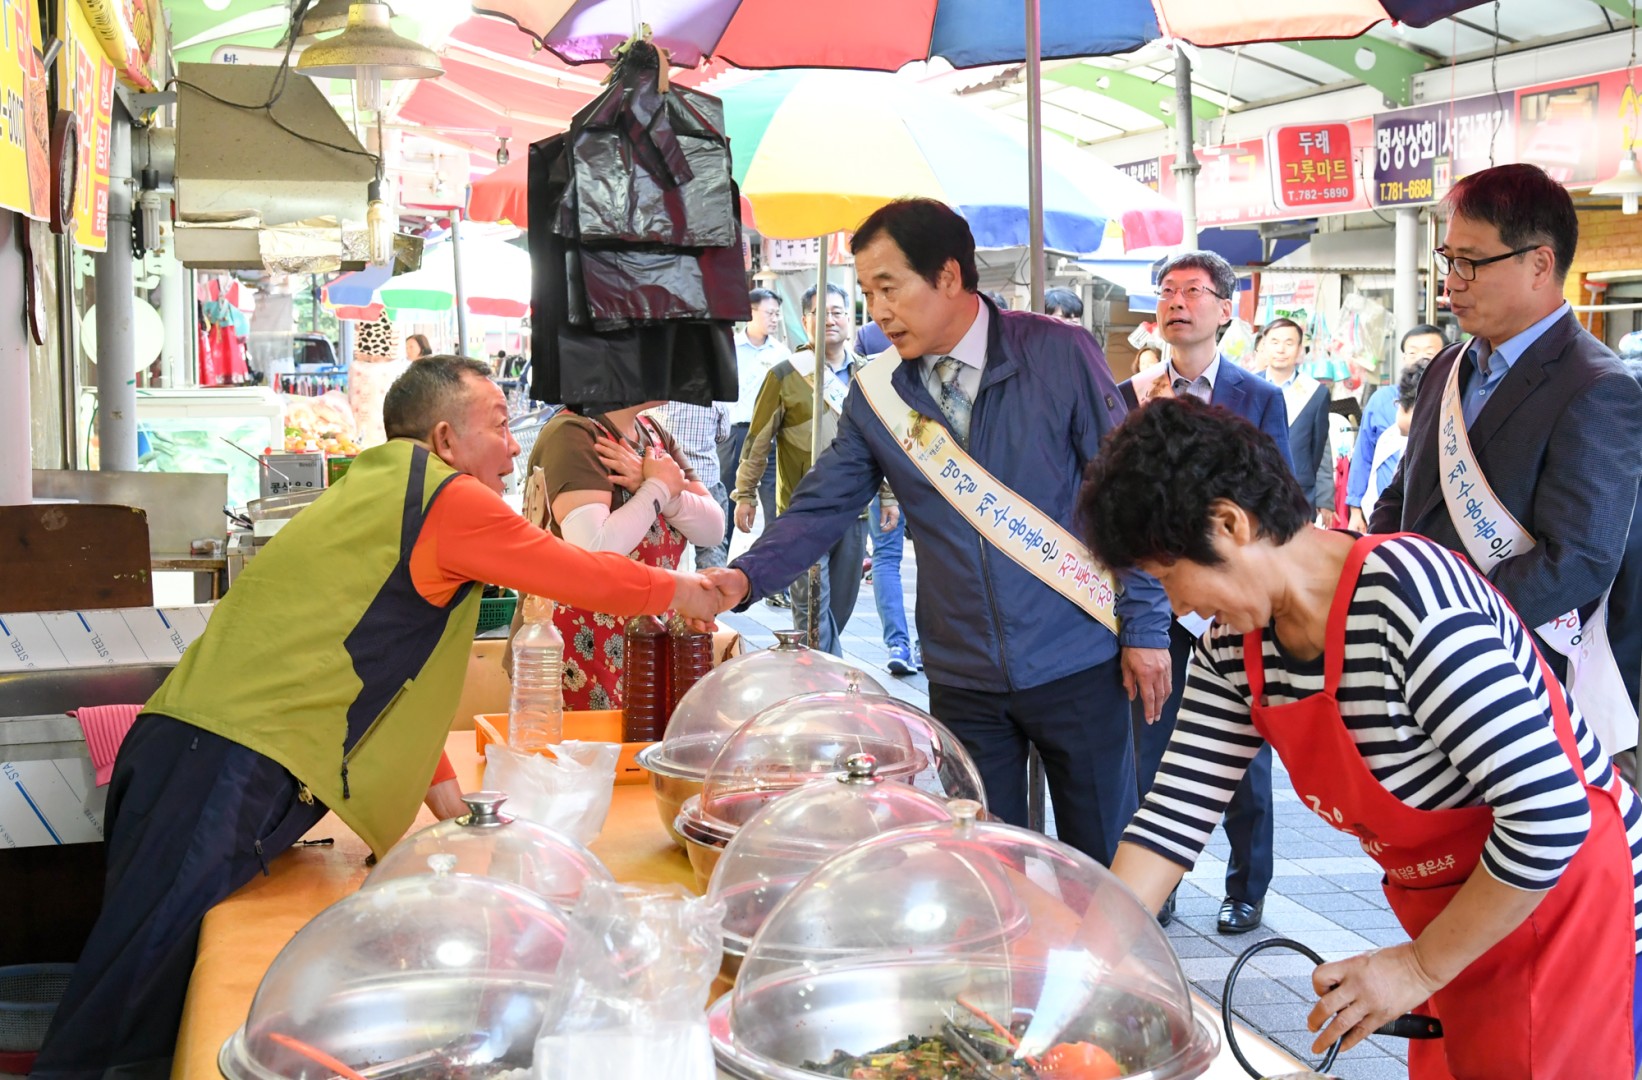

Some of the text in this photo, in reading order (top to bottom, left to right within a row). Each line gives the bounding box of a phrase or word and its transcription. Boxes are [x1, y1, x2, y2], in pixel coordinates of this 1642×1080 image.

[0, 87, 24, 150] -8007
[1298, 130, 1330, 156] 두래
[1377, 119, 1437, 171] 명성상회
[1285, 158, 1348, 184] 그릇마트
[1287, 186, 1349, 201] T.782-5890
[1380, 178, 1432, 201] T.781-6684
[1443, 414, 1512, 559] 명절 제수용품은
[940, 458, 978, 496] 명절
[975, 492, 1060, 563] 제수용품은
[11, 637, 29, 662] STEEL
[92, 632, 109, 658] STEEL
[171, 628, 187, 654] STEEL
[1416, 854, 1456, 877] 좋은소주
